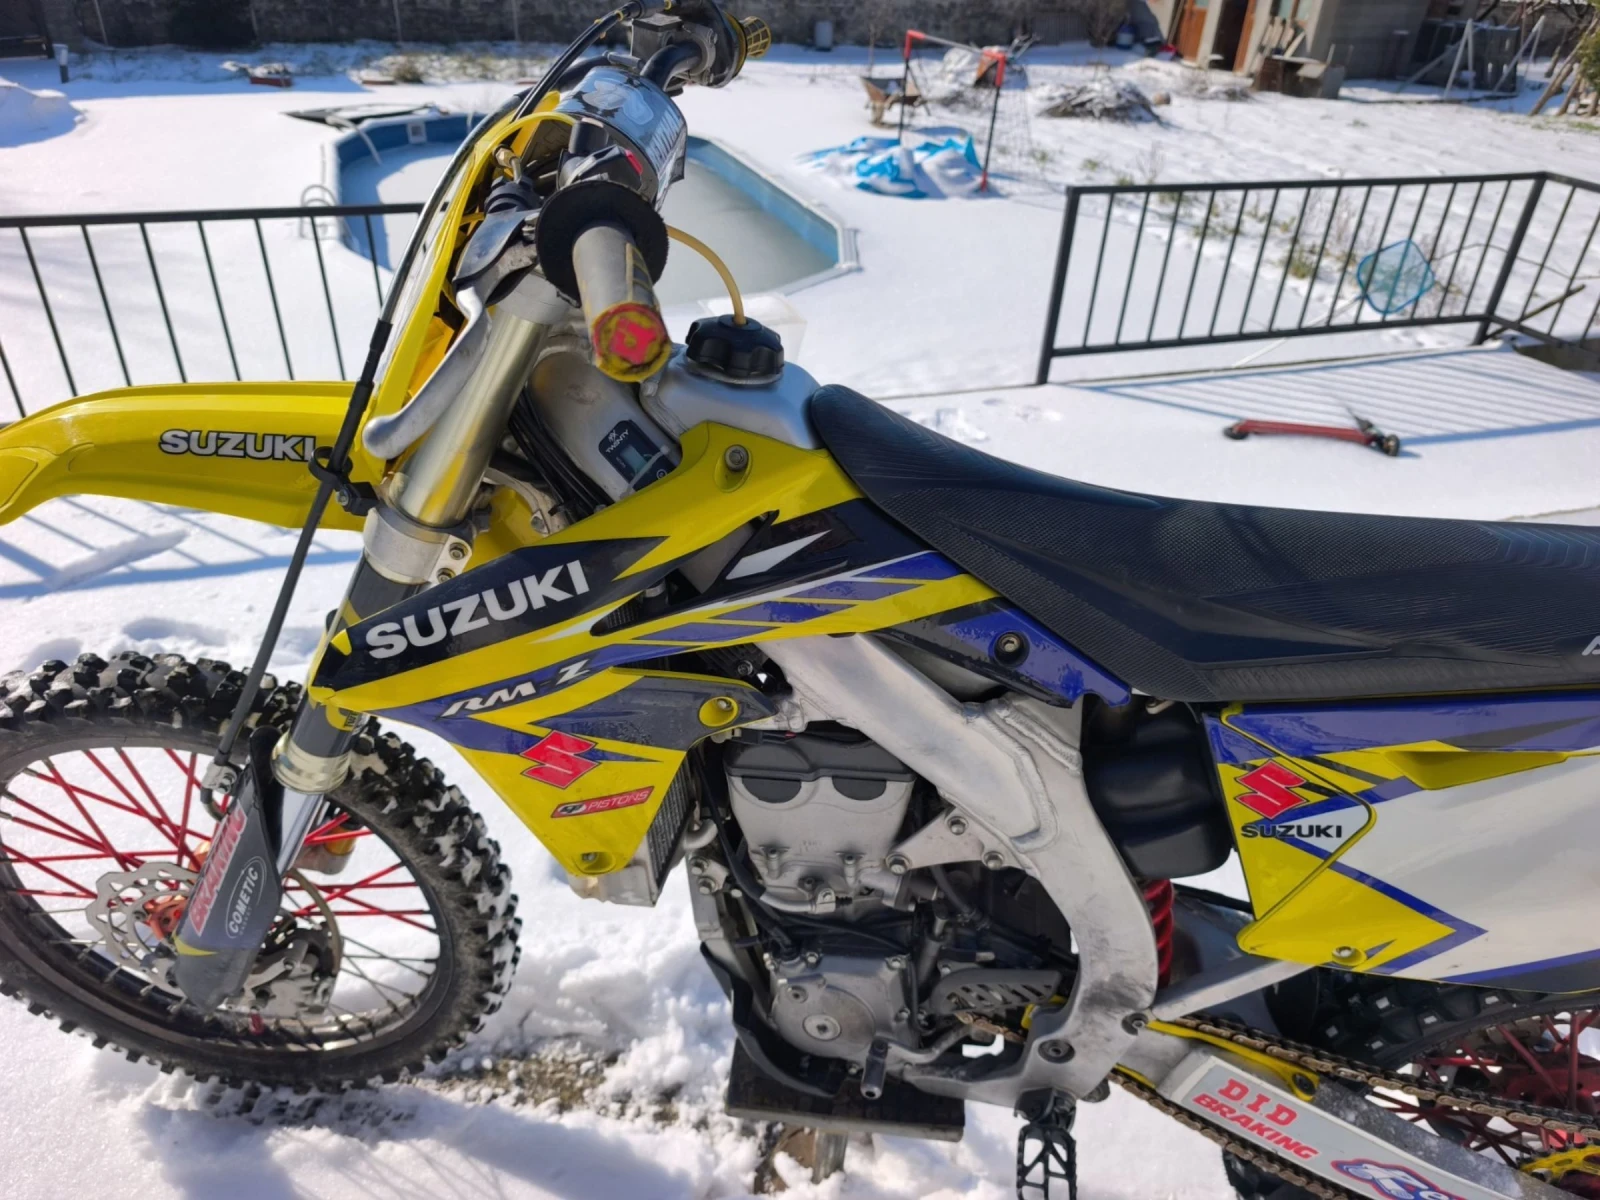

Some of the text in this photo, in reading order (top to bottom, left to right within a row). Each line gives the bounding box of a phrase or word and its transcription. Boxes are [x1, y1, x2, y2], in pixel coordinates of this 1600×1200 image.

[159, 428, 316, 462] SUZUKI
[365, 559, 591, 660] SUZUKI
[587, 788, 650, 811] PISTONS
[1240, 824, 1343, 839] SUZUKI
[228, 867, 259, 935] COMETIC
[1192, 1093, 1319, 1160] BRAKING
